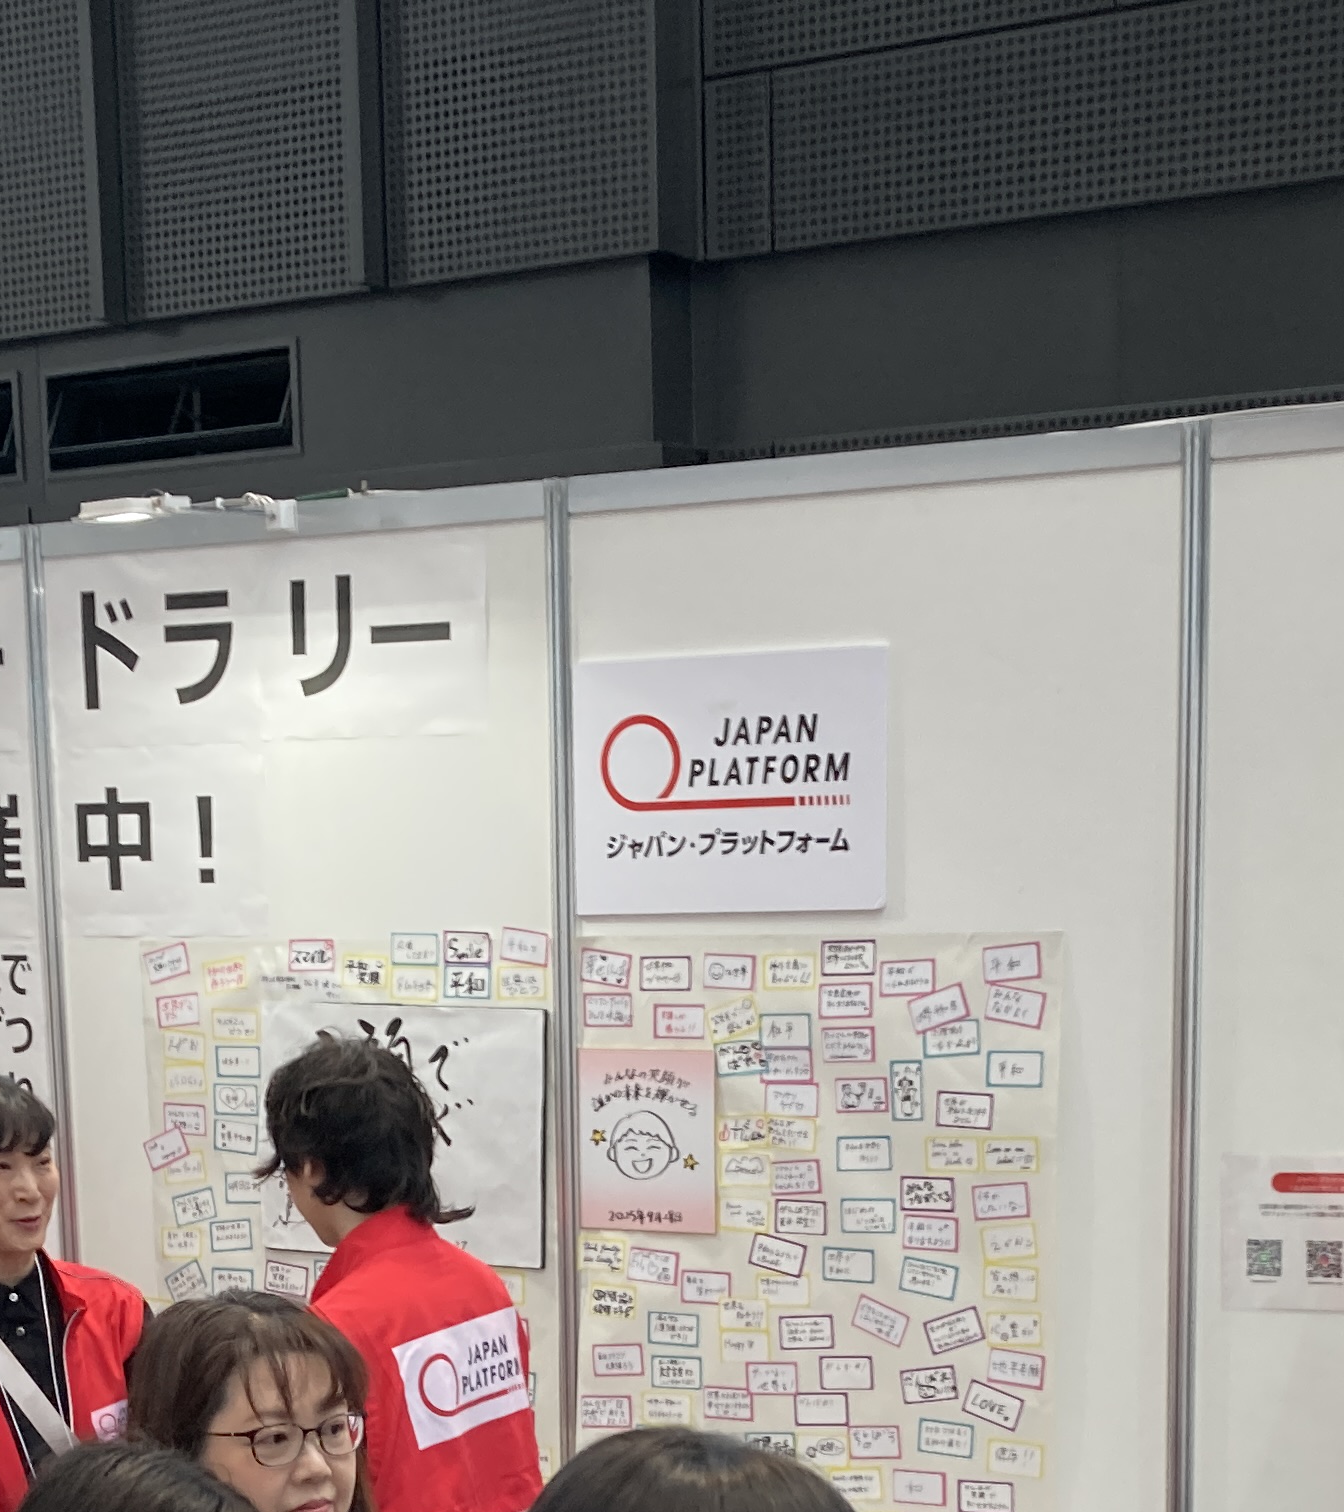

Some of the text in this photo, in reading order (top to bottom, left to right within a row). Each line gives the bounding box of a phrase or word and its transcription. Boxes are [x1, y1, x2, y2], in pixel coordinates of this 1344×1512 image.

[714, 713, 818, 746] JAPAN
[688, 751, 850, 788] PLATFORM
[606, 827, 850, 859] ジャパン・プラットフォーム
[467, 1334, 509, 1366] JAPAN
